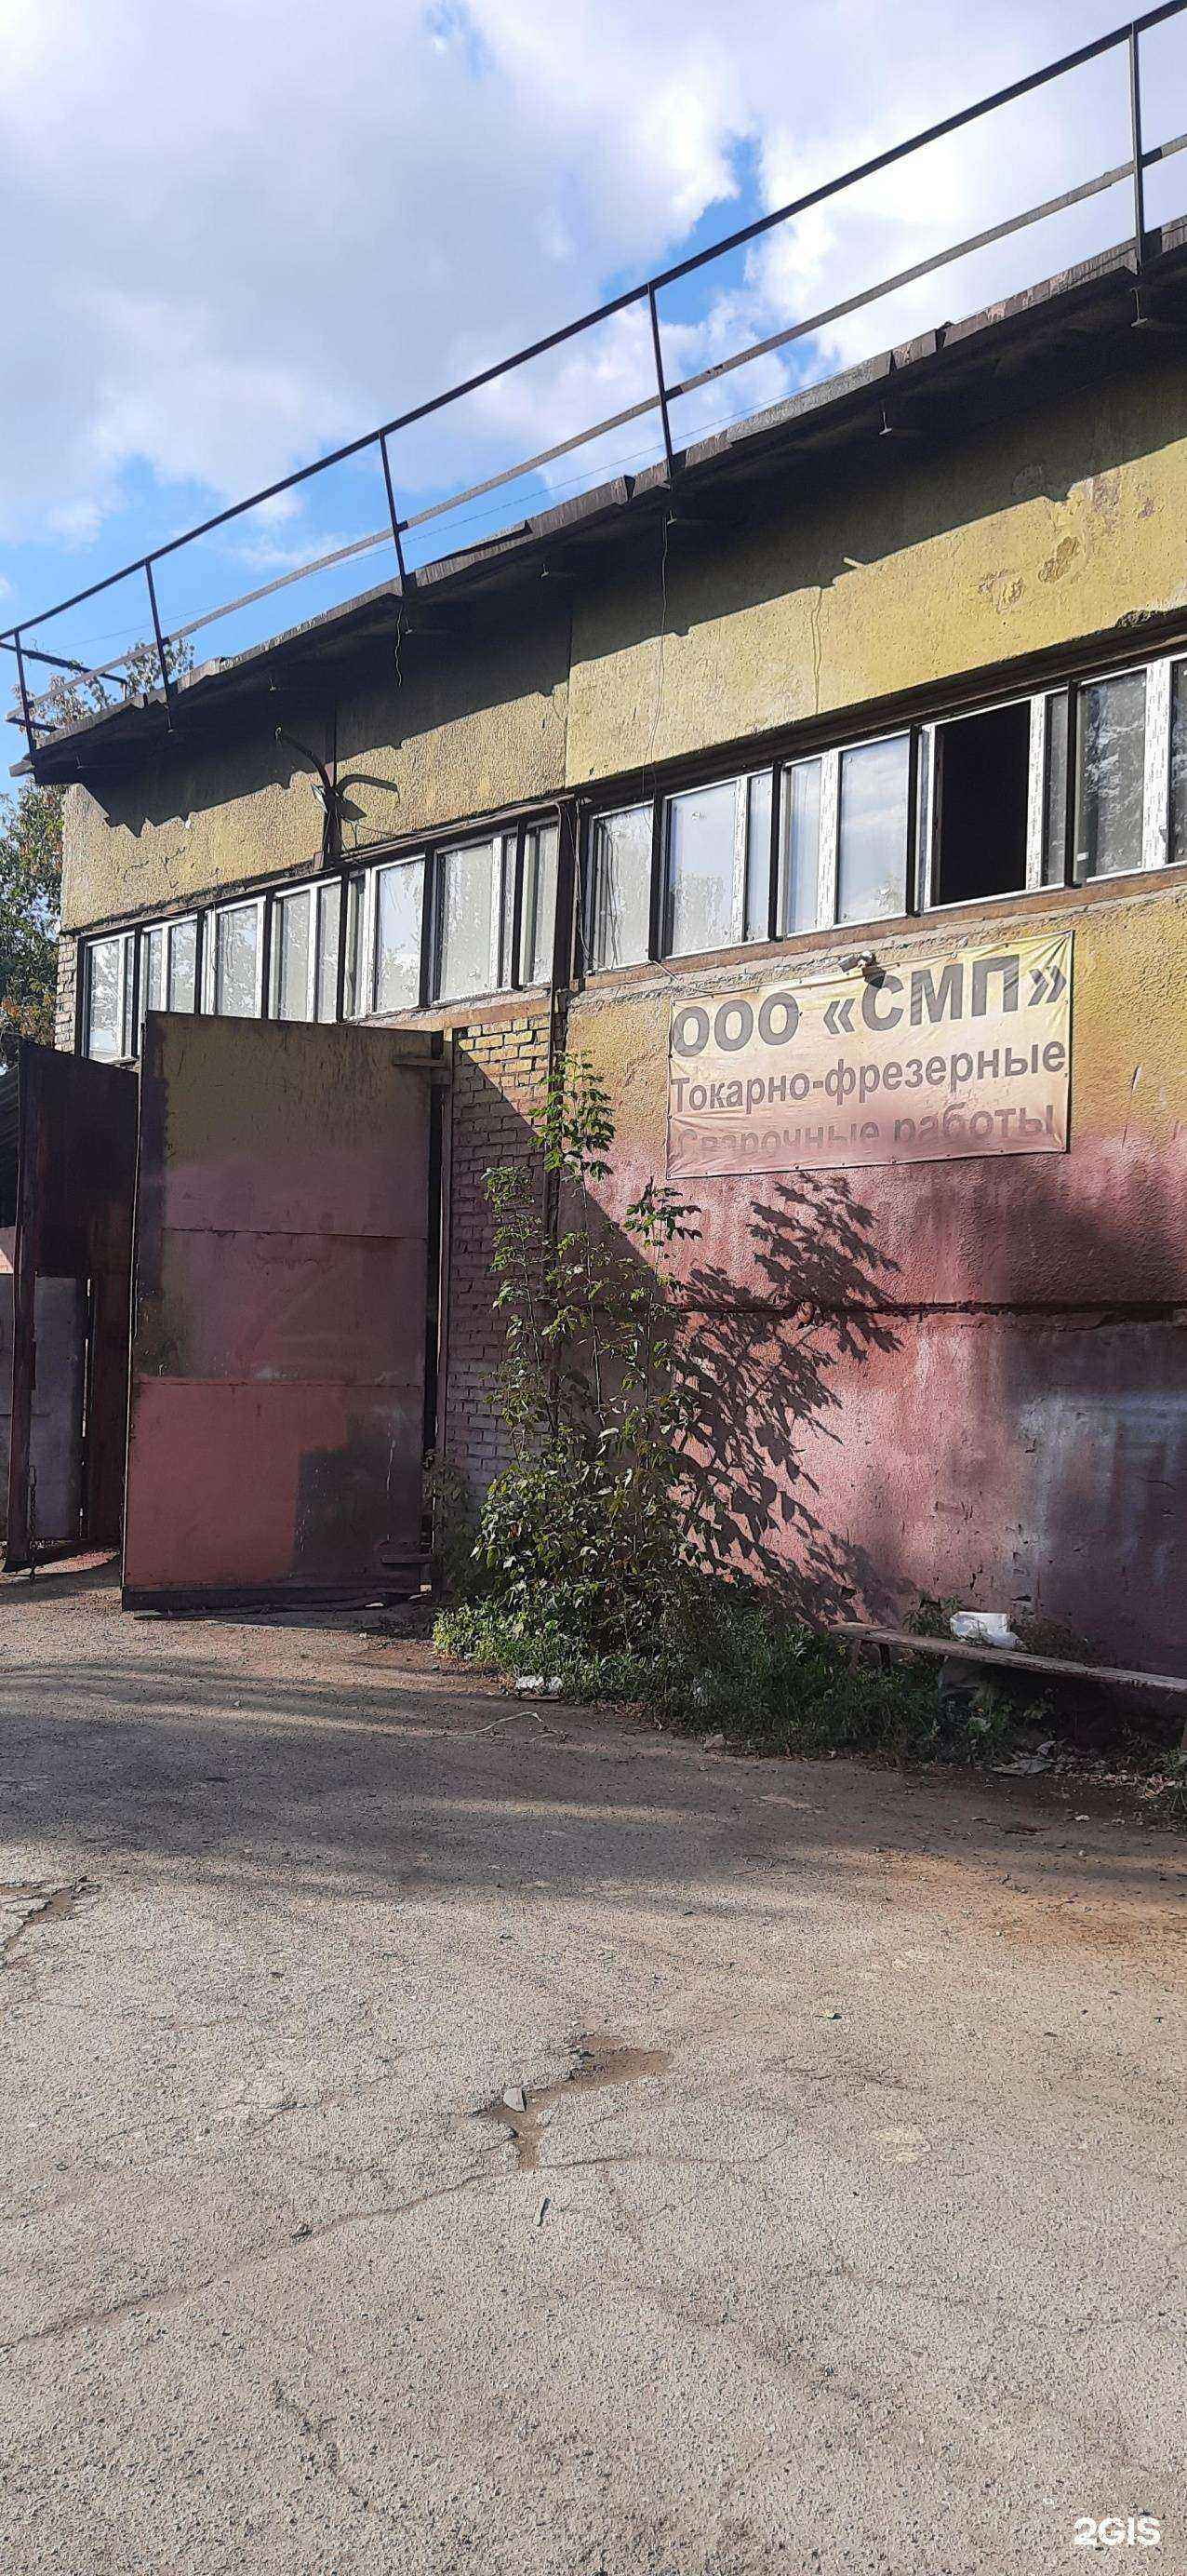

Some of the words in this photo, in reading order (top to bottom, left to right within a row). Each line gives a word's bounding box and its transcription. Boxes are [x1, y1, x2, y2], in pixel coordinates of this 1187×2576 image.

[673, 991, 800, 1058] ООО
[823, 953, 1068, 1034] «СМП»
[671, 1040, 1067, 1115] Токарно-фрезерные
[894, 1101, 1055, 1143] работы
